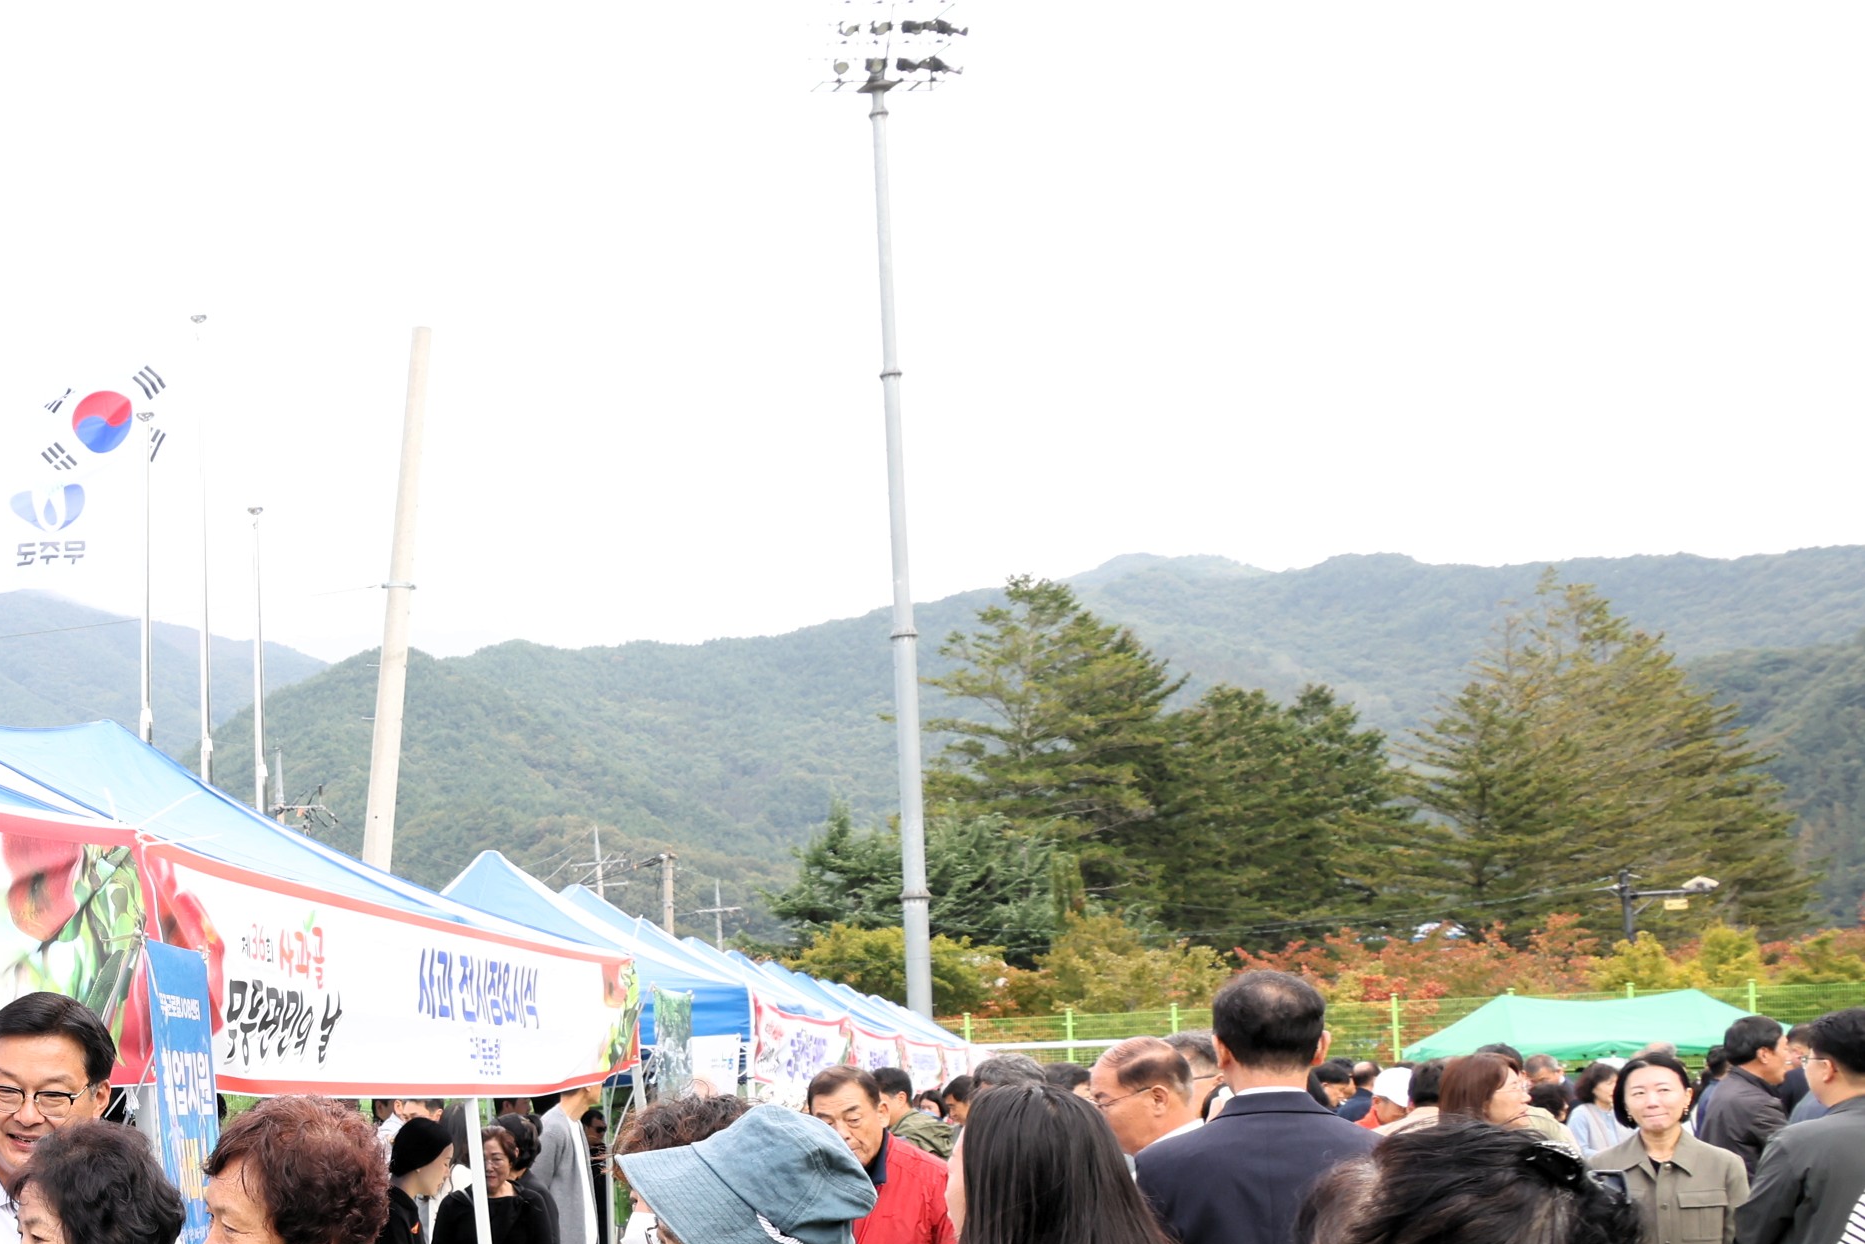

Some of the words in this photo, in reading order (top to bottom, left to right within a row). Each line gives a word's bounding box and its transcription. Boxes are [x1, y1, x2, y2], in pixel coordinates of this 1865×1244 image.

[241, 923, 274, 964] 제36회
[279, 926, 325, 989] 사과골
[418, 947, 455, 1021] 사과
[459, 954, 539, 1030] 전시장&시식
[226, 978, 315, 1067] 무풍면민의
[320, 990, 343, 1064] 날
[161, 1046, 214, 1116] 취업지원
